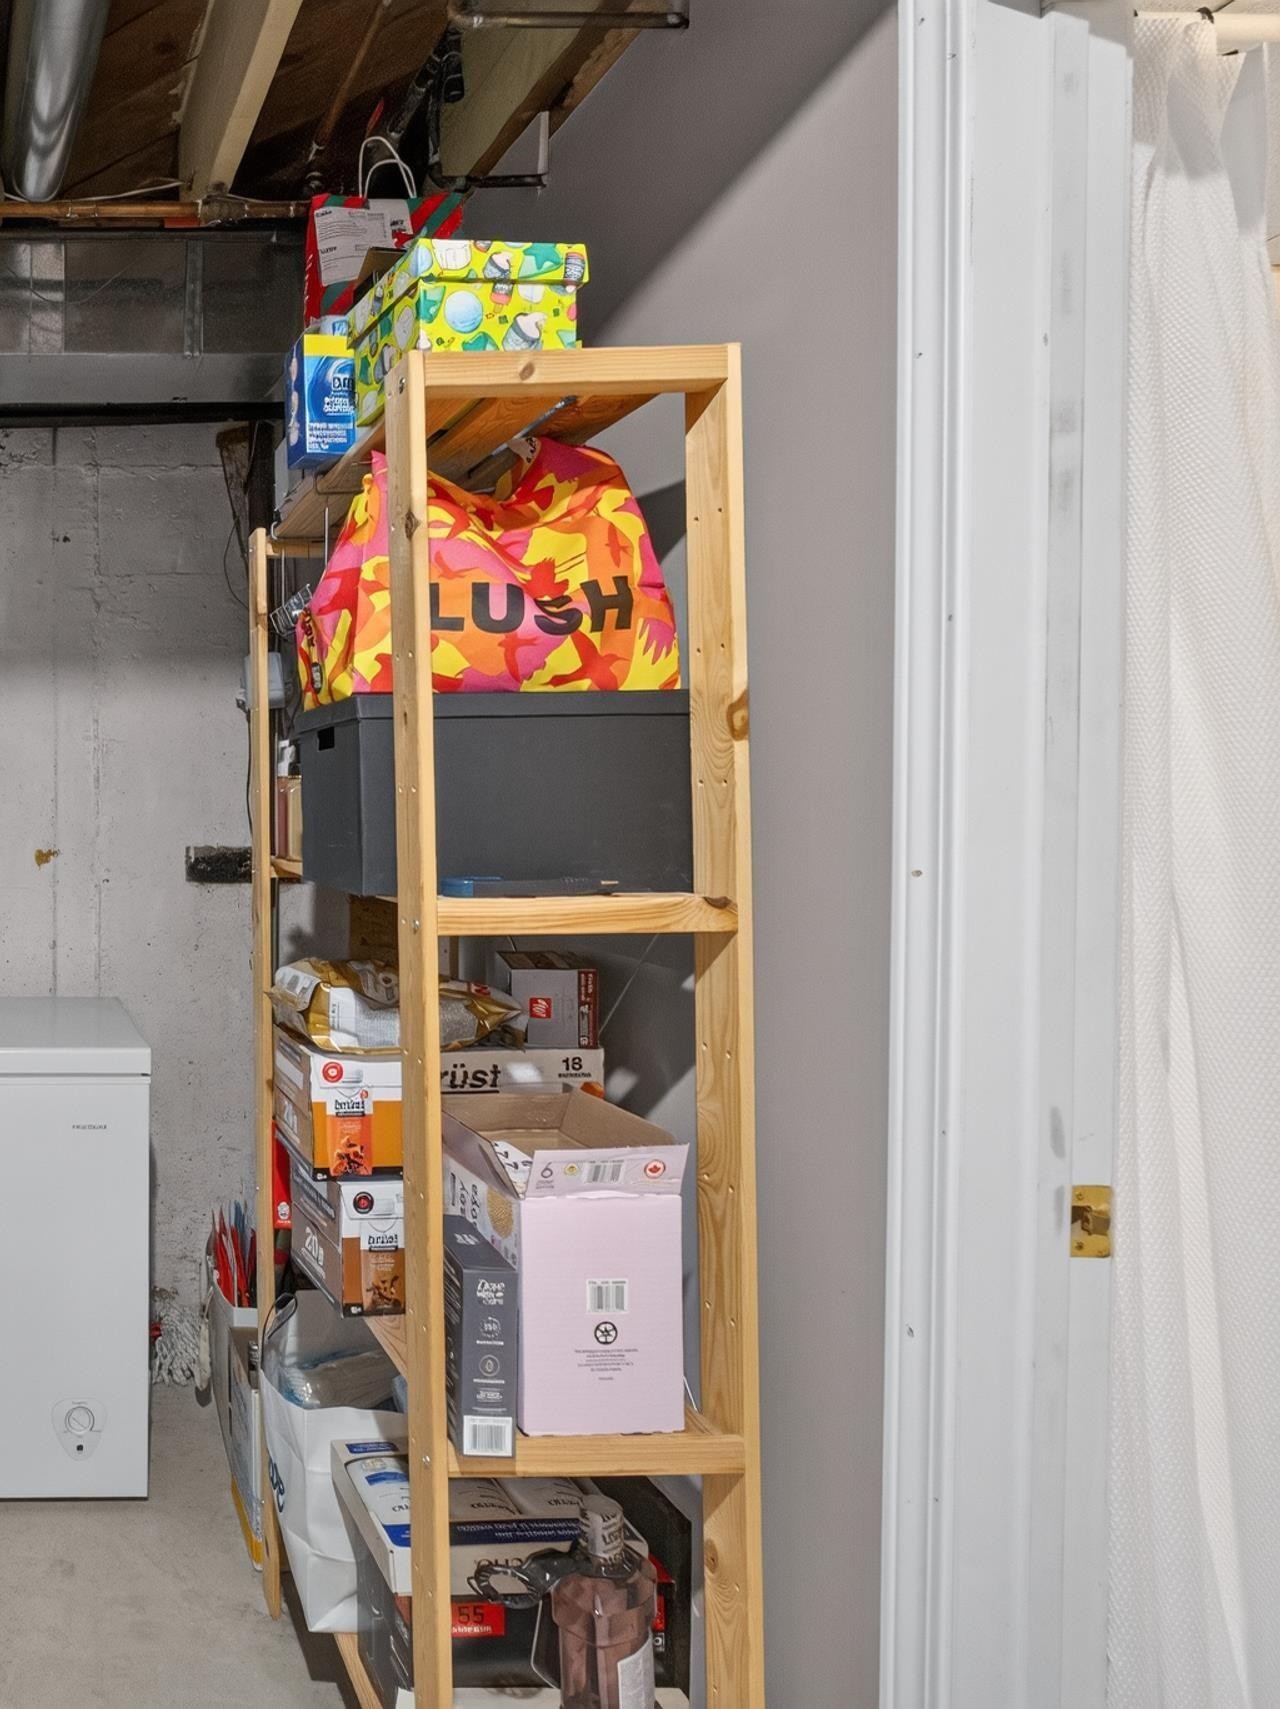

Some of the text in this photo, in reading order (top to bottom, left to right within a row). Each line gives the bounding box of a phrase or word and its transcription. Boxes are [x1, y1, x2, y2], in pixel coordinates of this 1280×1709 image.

[429, 575, 634, 636] LUSH
[562, 1056, 583, 1071] 18
[540, 1161, 554, 1179] 6
[457, 1605, 485, 1625] 55
